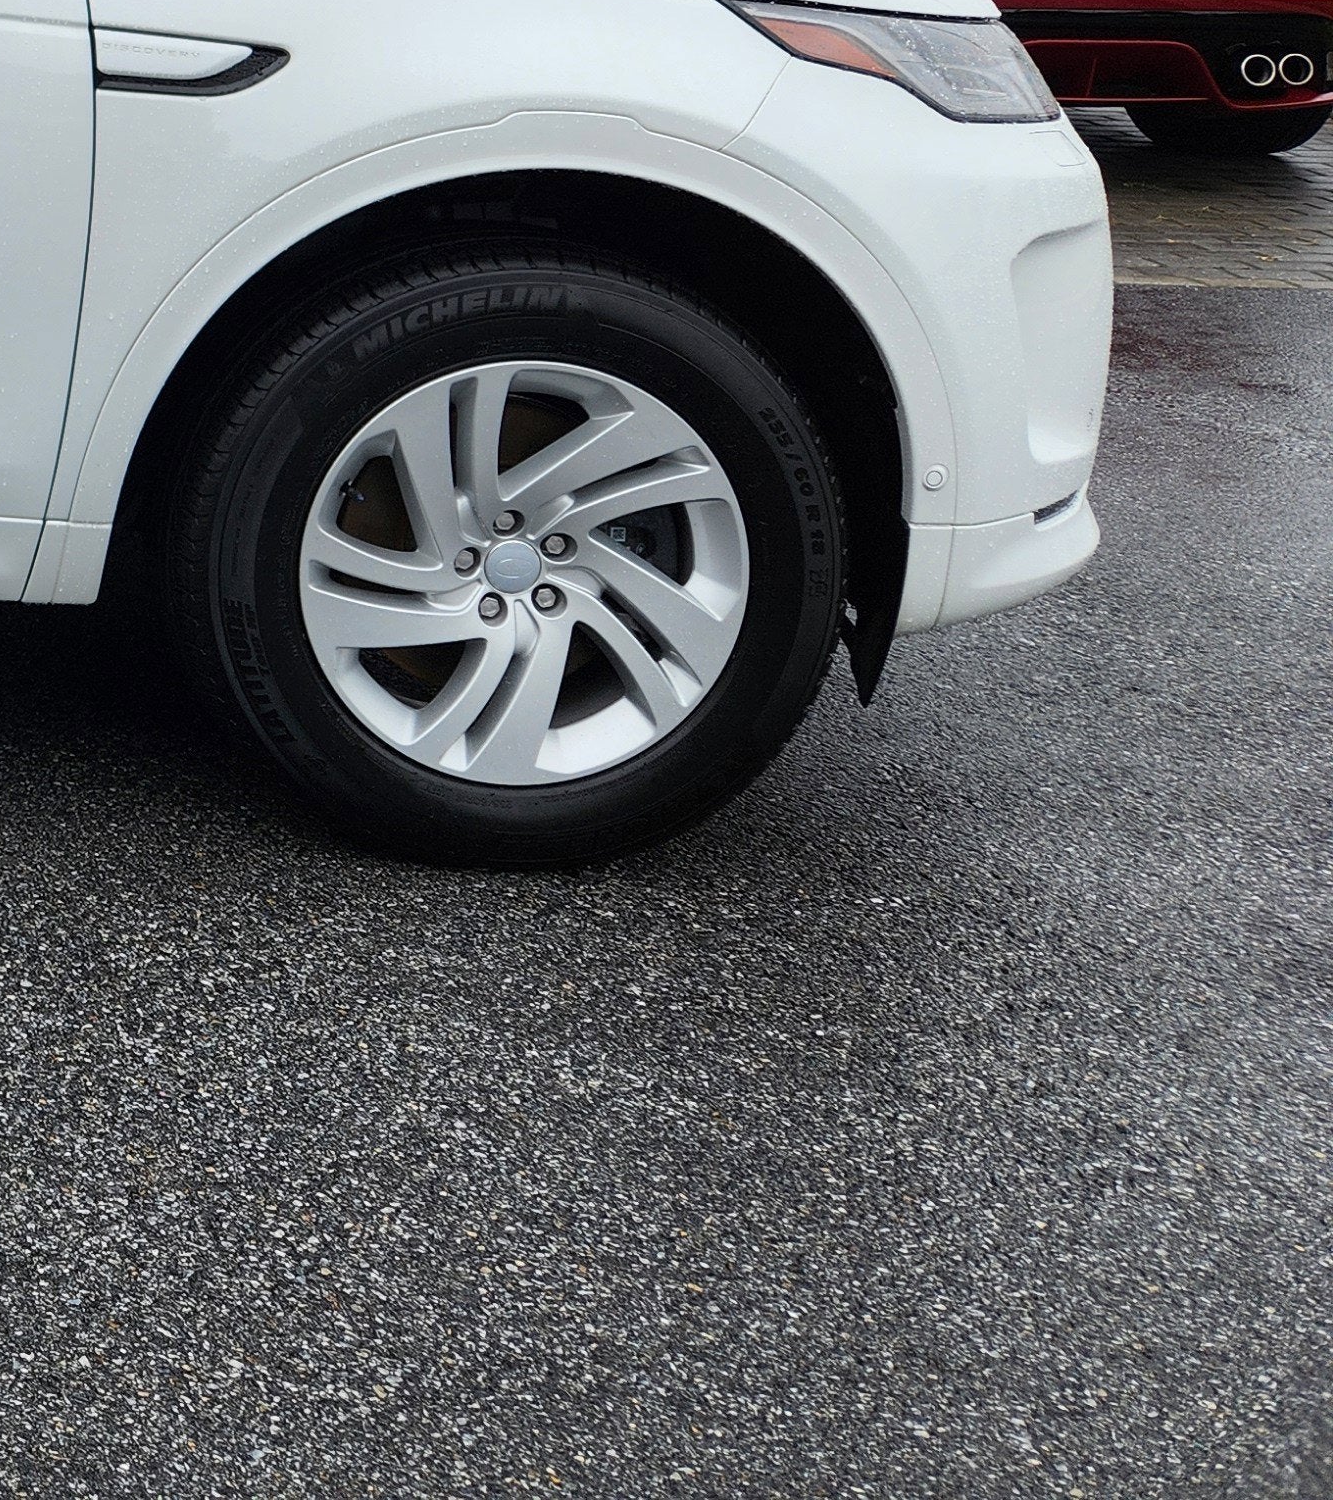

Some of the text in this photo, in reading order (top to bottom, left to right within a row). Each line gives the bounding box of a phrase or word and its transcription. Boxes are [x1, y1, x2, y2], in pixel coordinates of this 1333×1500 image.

[102, 42, 200, 58] DISCOVERY
[352, 285, 564, 358] MICHELIN
[223, 598, 298, 743] LATITUDE
